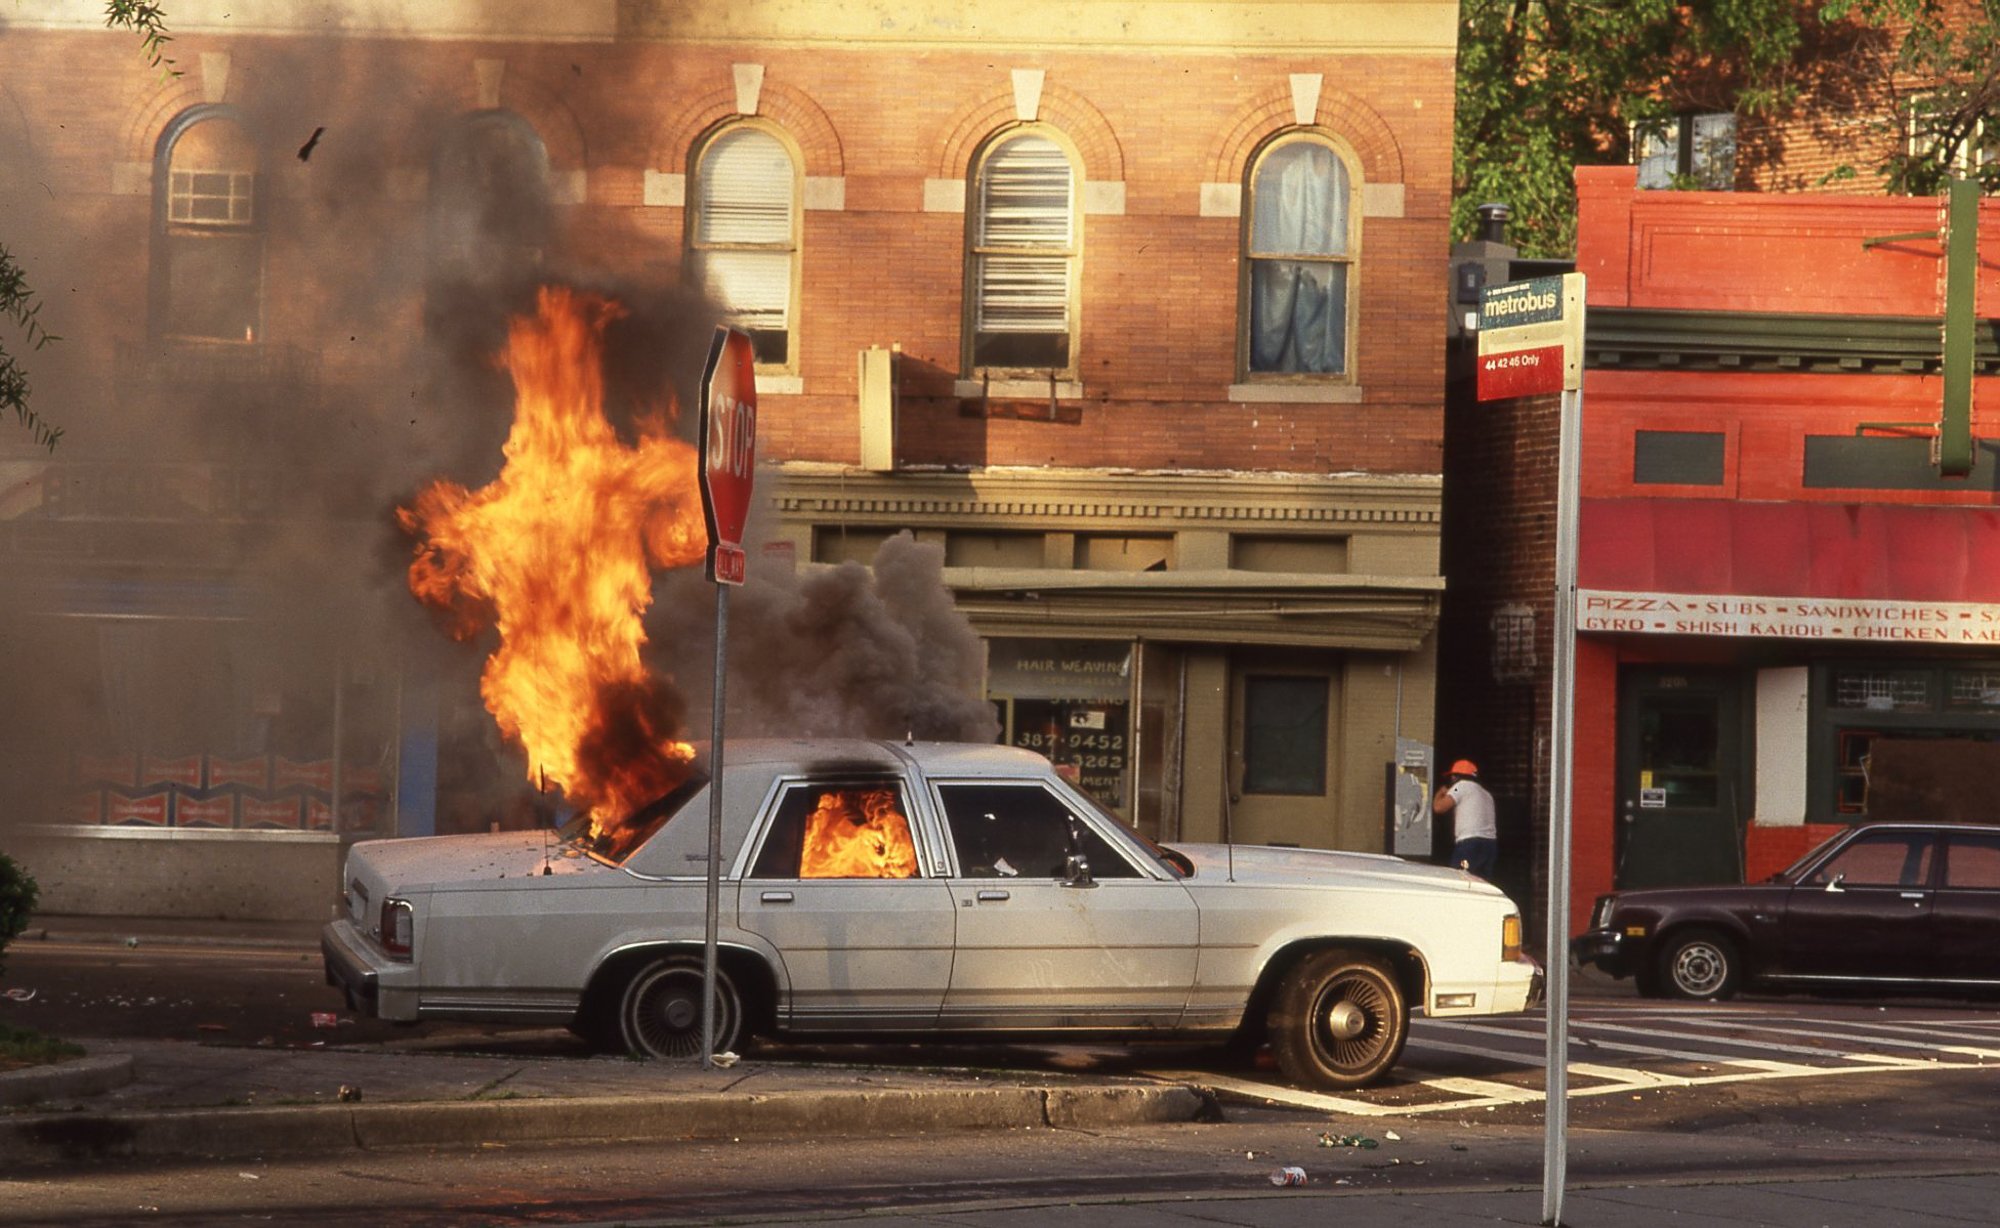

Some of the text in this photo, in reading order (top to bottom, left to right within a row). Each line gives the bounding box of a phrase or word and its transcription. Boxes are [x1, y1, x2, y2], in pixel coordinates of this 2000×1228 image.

[1485, 292, 1556, 317] metrobus
[1485, 360, 1496, 371] 44
[1498, 358, 1508, 368] 42
[1521, 354, 1540, 366] Only
[711, 393, 754, 480] STOP
[1587, 597, 1681, 612] PIZZA
[1705, 601, 1767, 615] SUBS
[1796, 604, 1949, 622] SANDWICHES
[1586, 617, 1644, 631] GYRO
[1675, 620, 1737, 634] SHISH
[1750, 624, 1824, 638] KABOB
[1853, 626, 1948, 640] CHICKEN
[1017, 659, 1055, 672] HAIR
